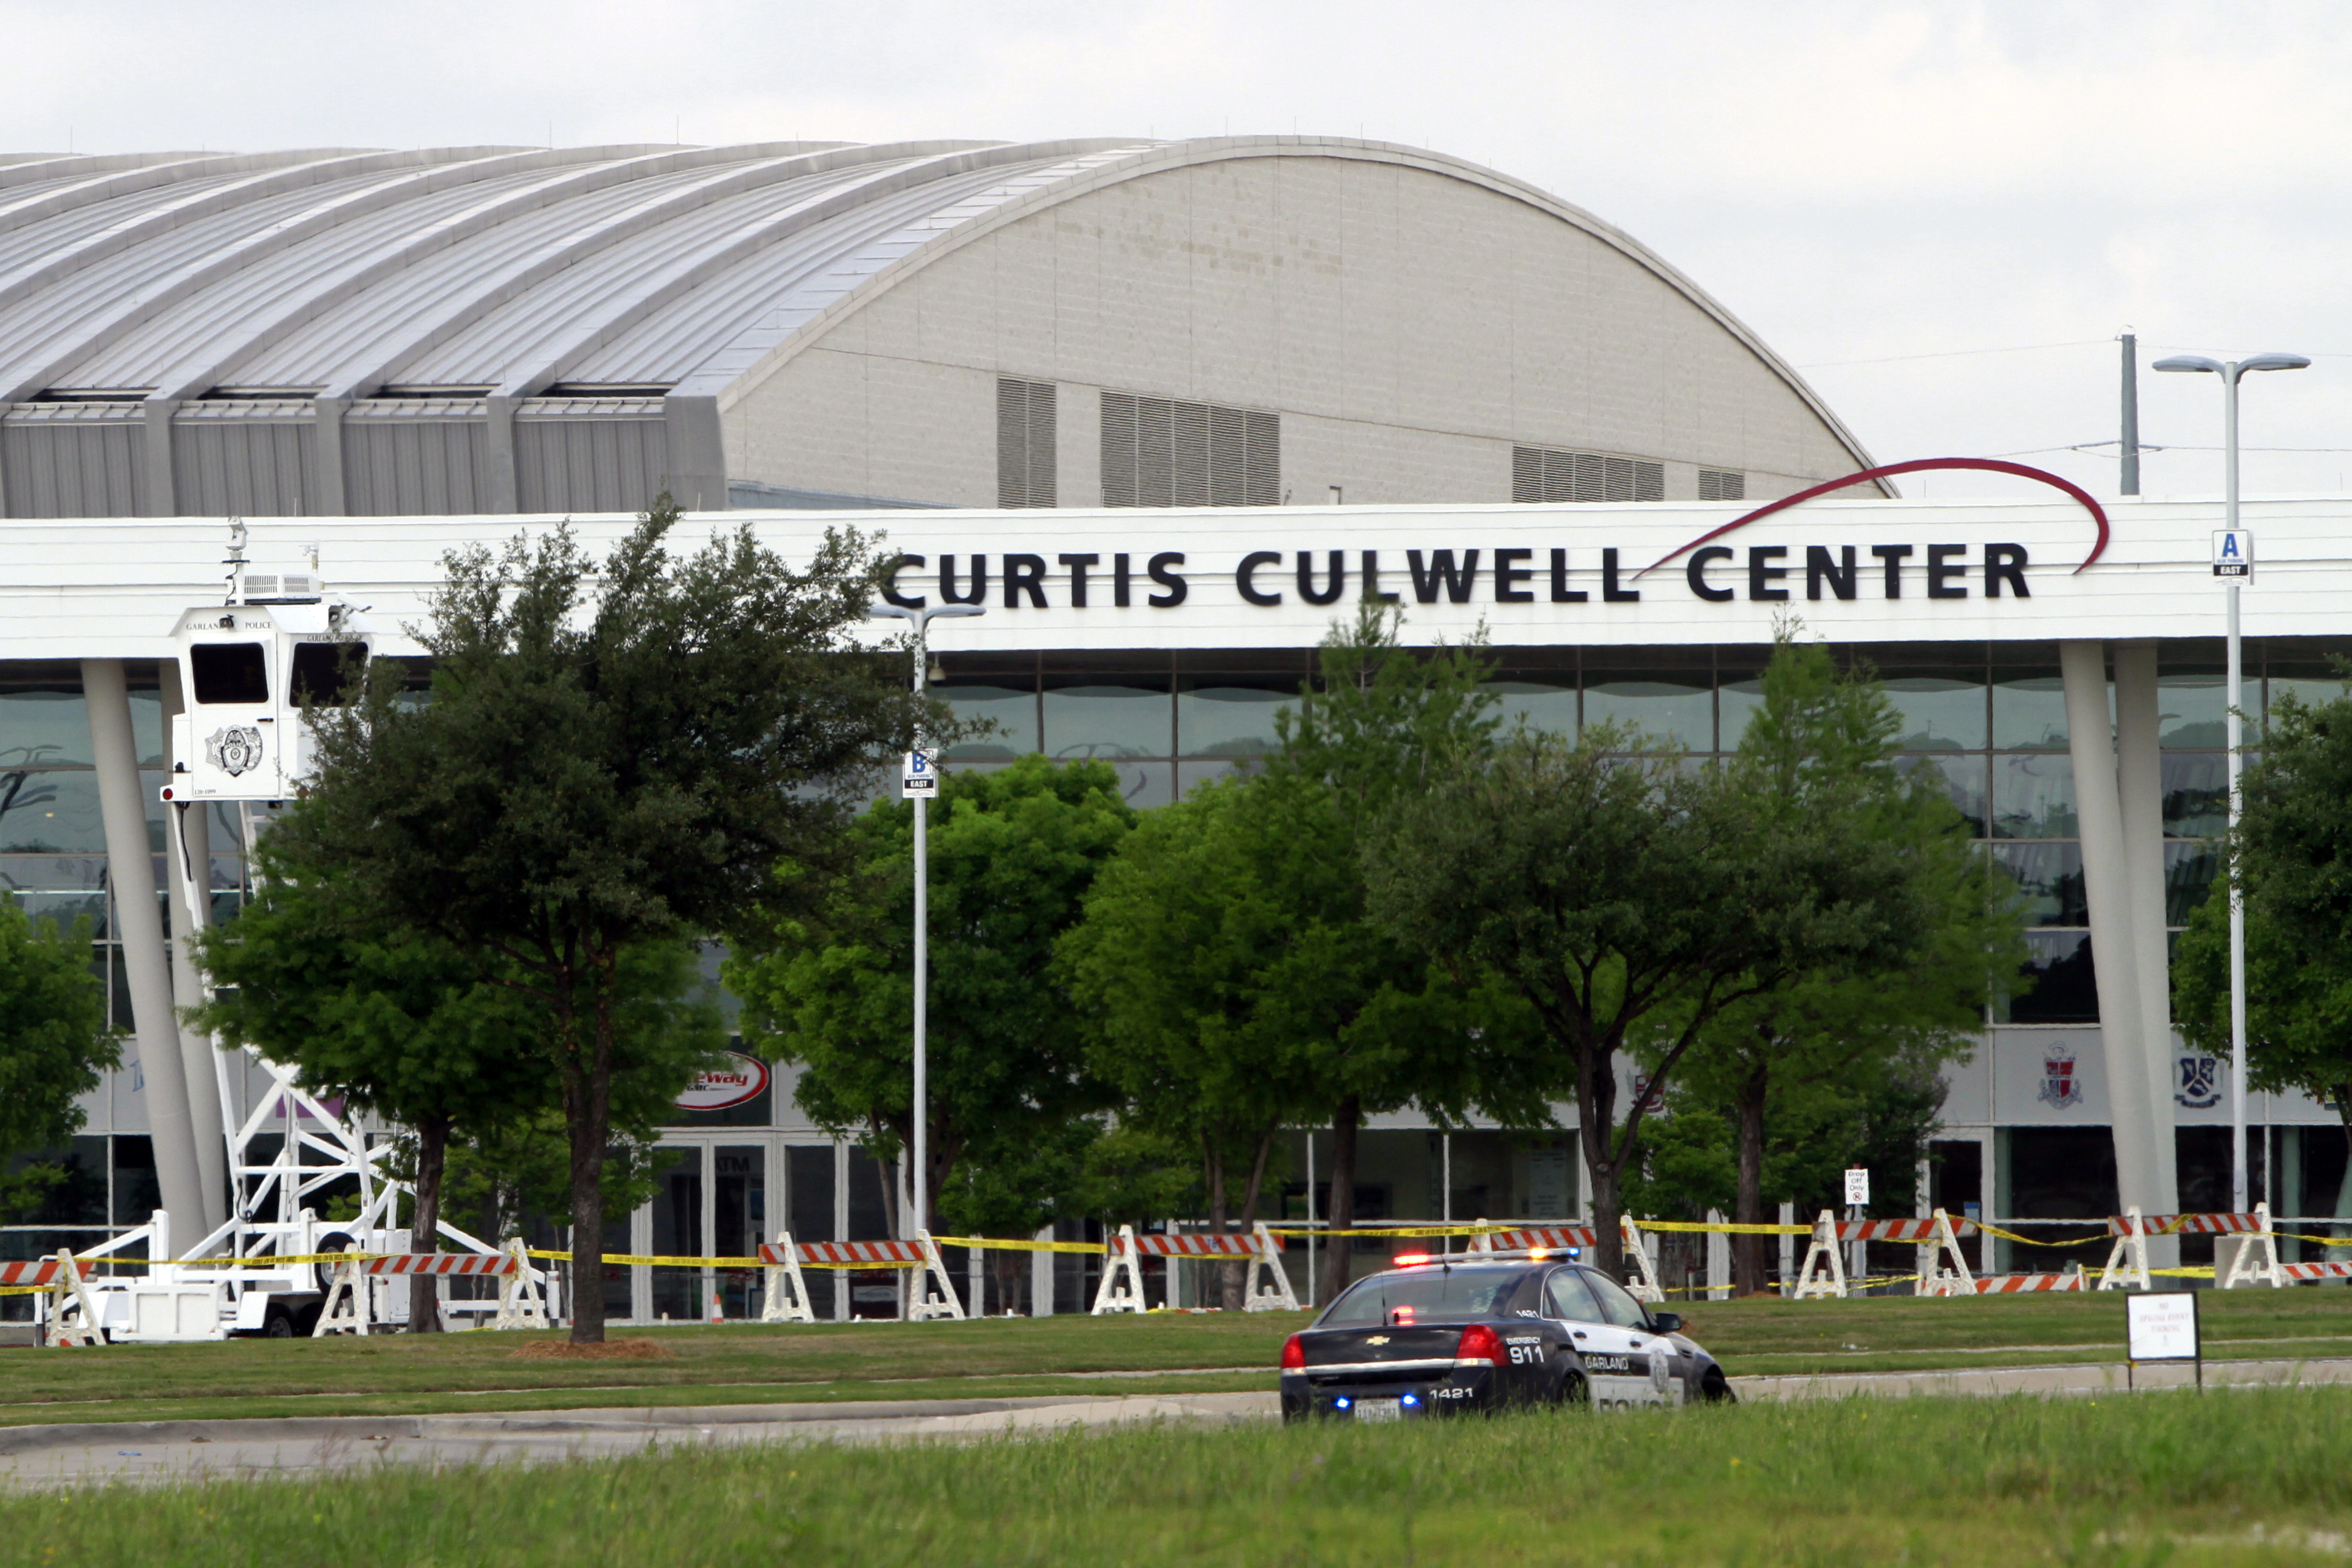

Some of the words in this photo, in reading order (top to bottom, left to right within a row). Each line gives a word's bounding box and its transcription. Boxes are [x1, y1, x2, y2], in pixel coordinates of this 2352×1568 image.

[2222, 533, 2239, 557] A
[880, 551, 1189, 609] CURTIS
[1235, 547, 1640, 607] CULWELL
[1686, 543, 2031, 602] CENTER
[2220, 565, 2241, 575] EAST
[912, 750, 926, 773] B
[1516, 1310, 1540, 1319] 1421
[1510, 1345, 1544, 1364] 911
[1585, 1356, 1629, 1371] GARLAND
[1430, 1387, 1473, 1400] 1421
